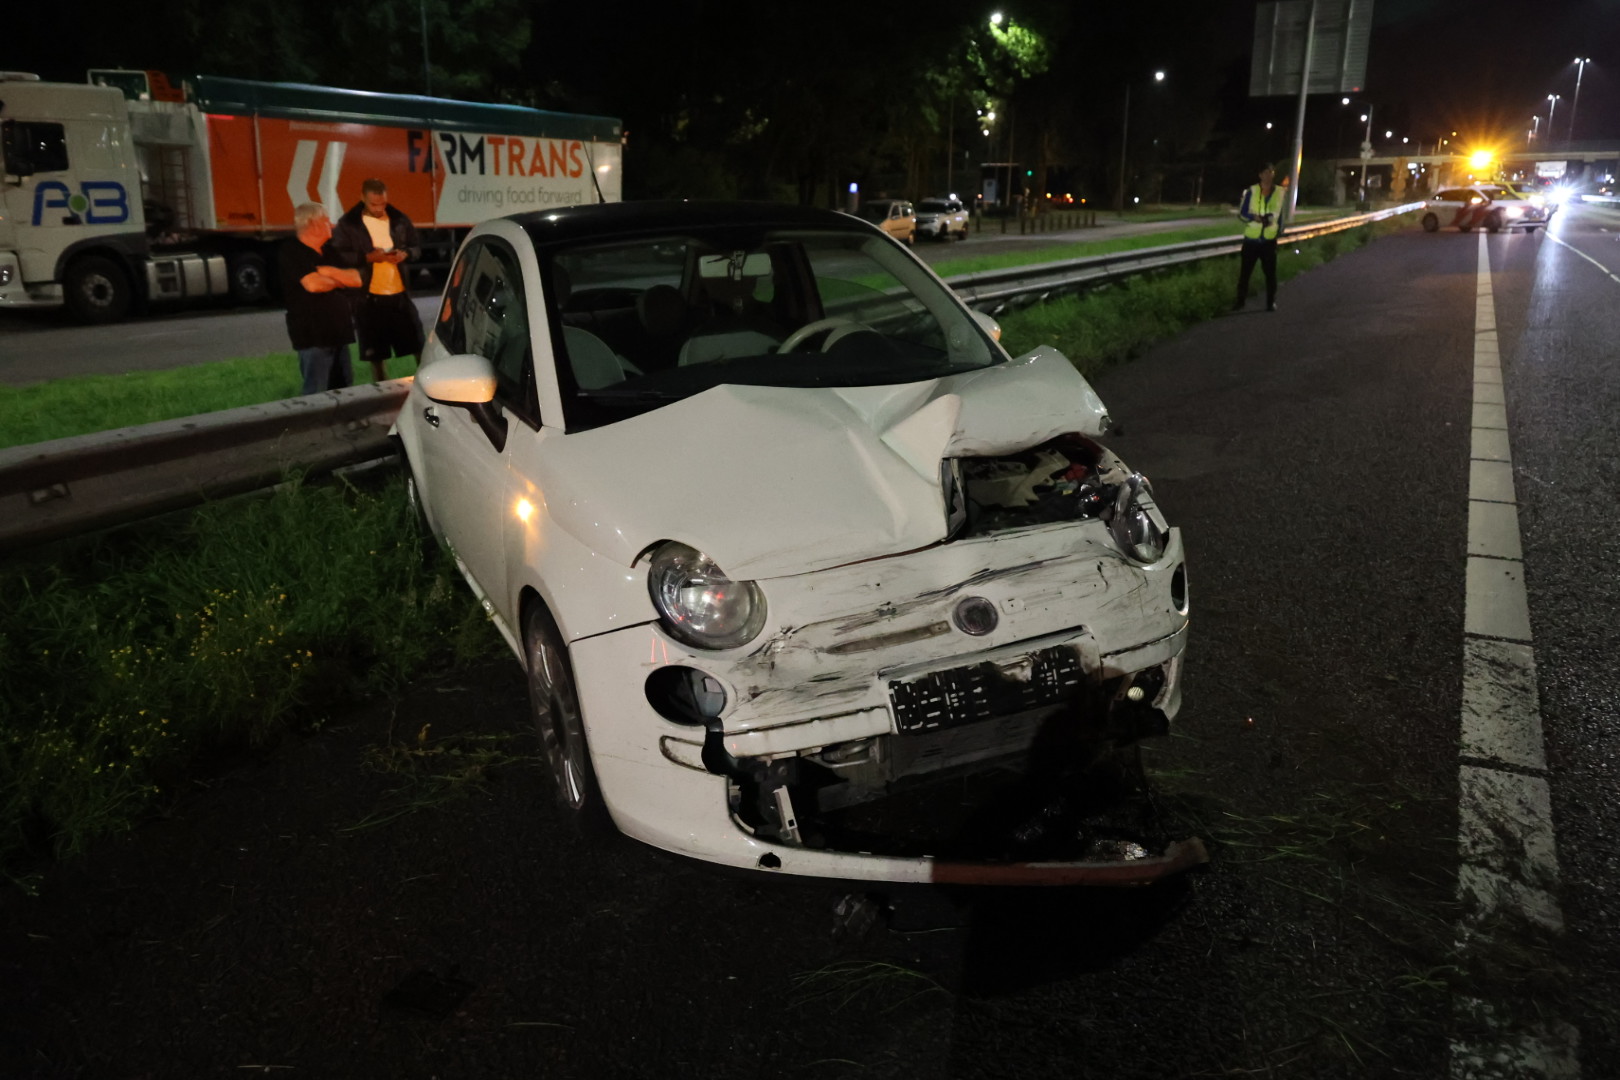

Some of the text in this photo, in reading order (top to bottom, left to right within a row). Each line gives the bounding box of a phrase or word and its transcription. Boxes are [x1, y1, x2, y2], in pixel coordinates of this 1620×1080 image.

[407, 131, 583, 178] FARMTRANS
[458, 186, 582, 207] driving food forward
